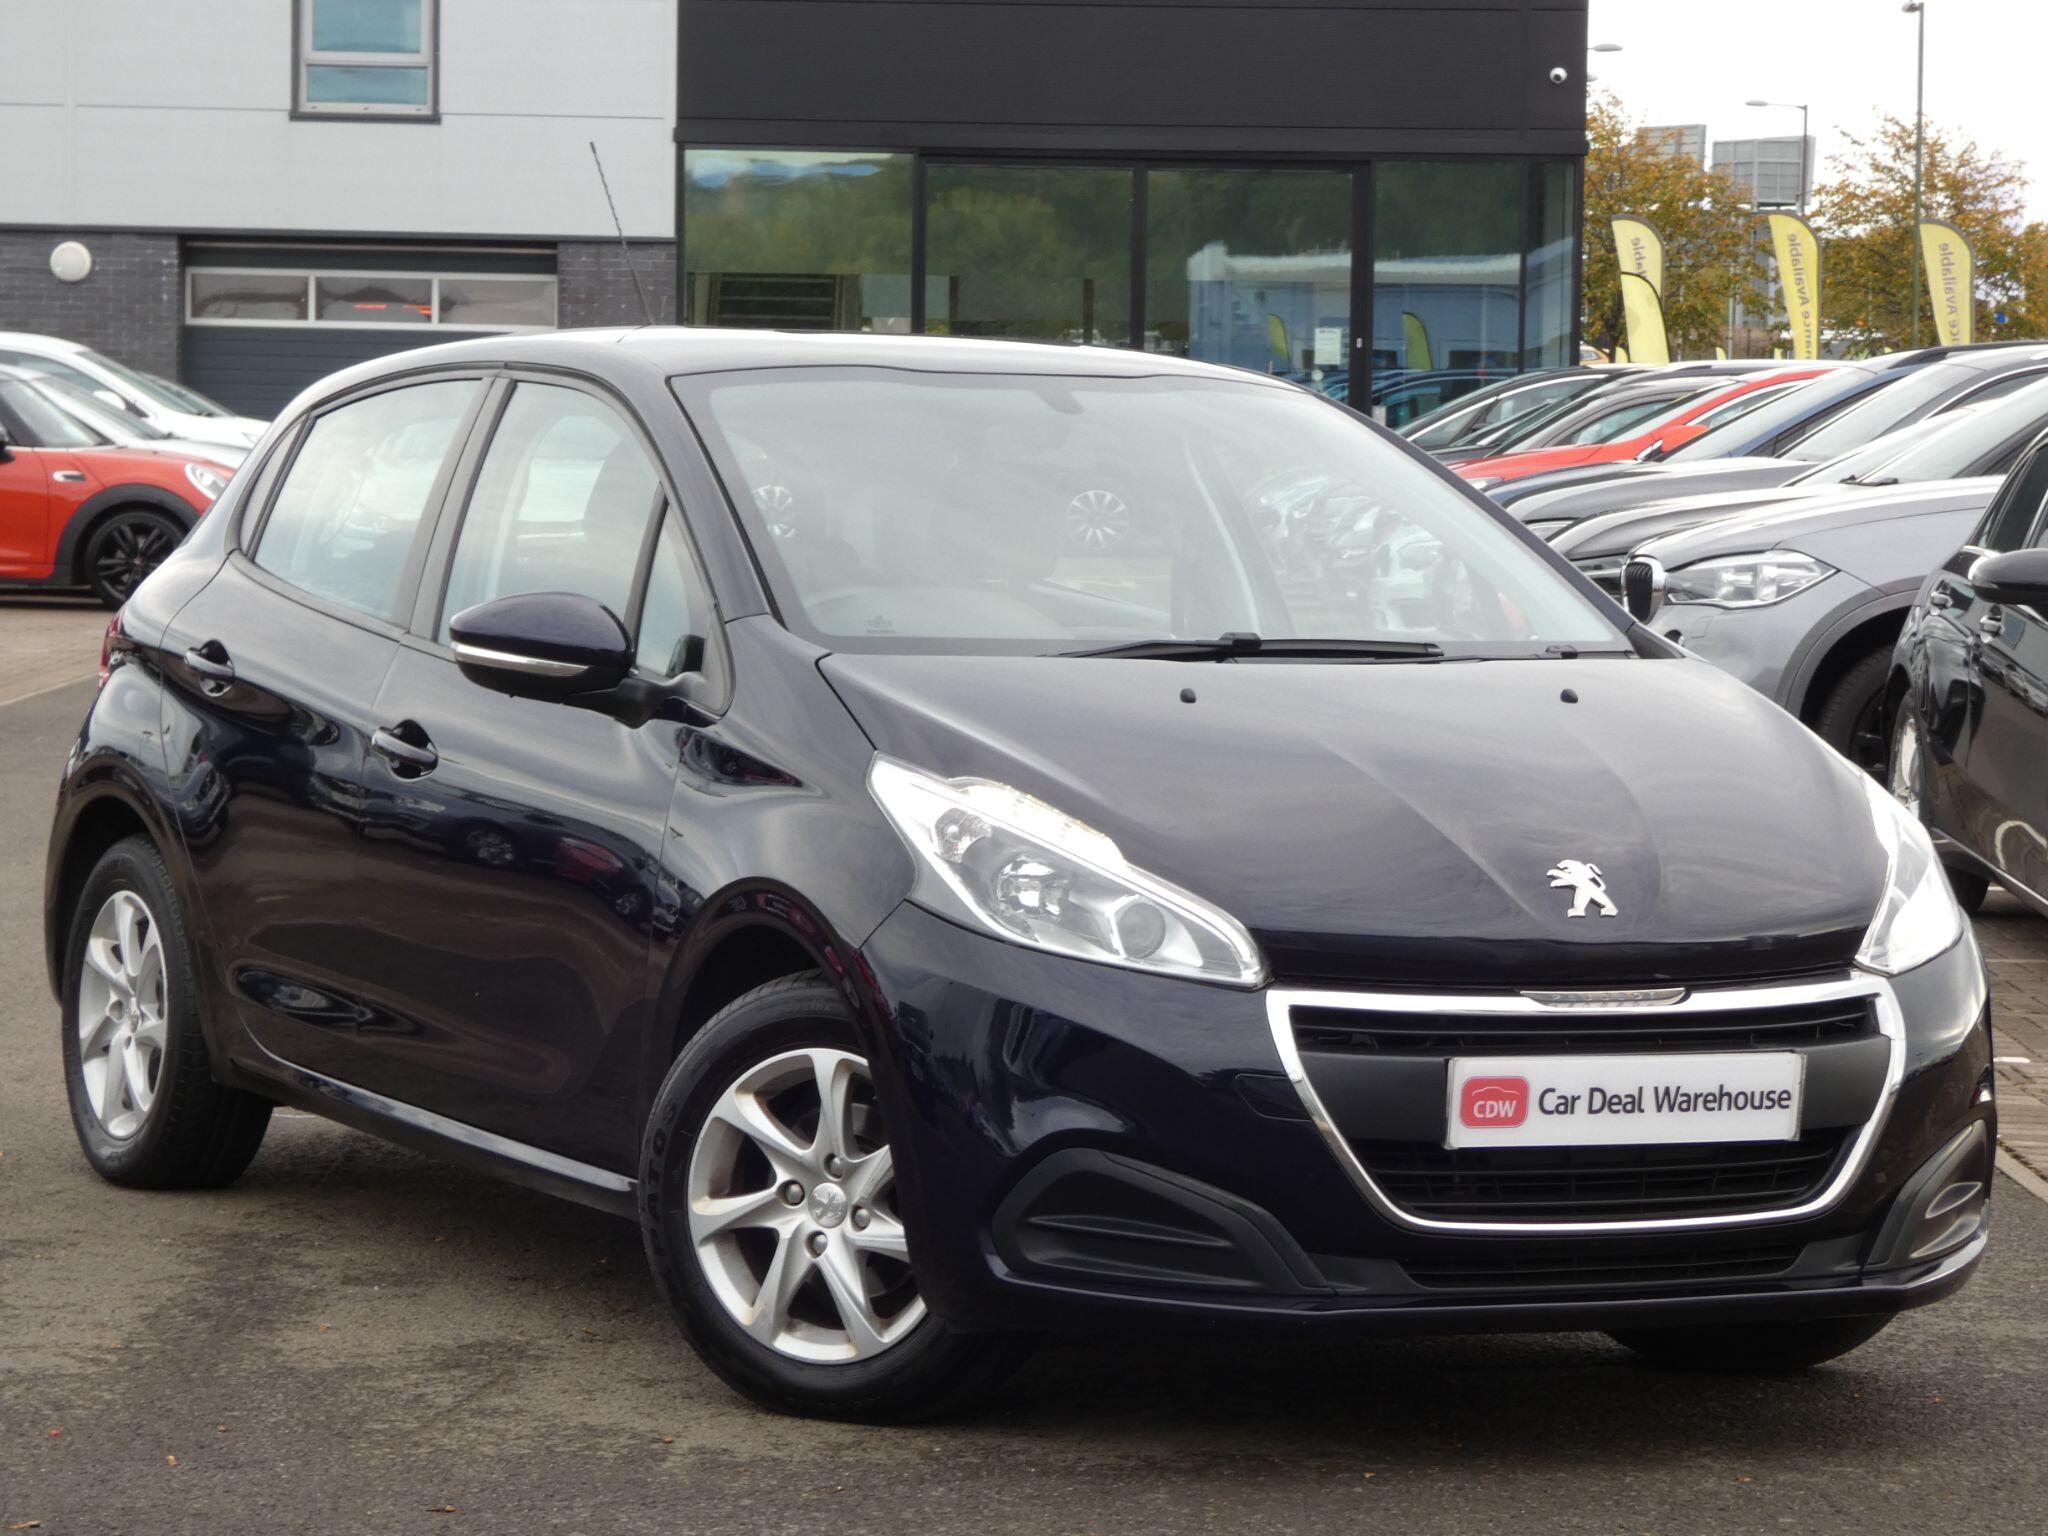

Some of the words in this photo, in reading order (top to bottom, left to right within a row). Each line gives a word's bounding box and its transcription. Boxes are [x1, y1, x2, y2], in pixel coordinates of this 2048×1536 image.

[1473, 1100, 1517, 1118] CDW
[1538, 1087, 1581, 1115] Car
[1587, 1086, 1645, 1114] Deal
[1653, 1083, 1792, 1113] Warehouse
